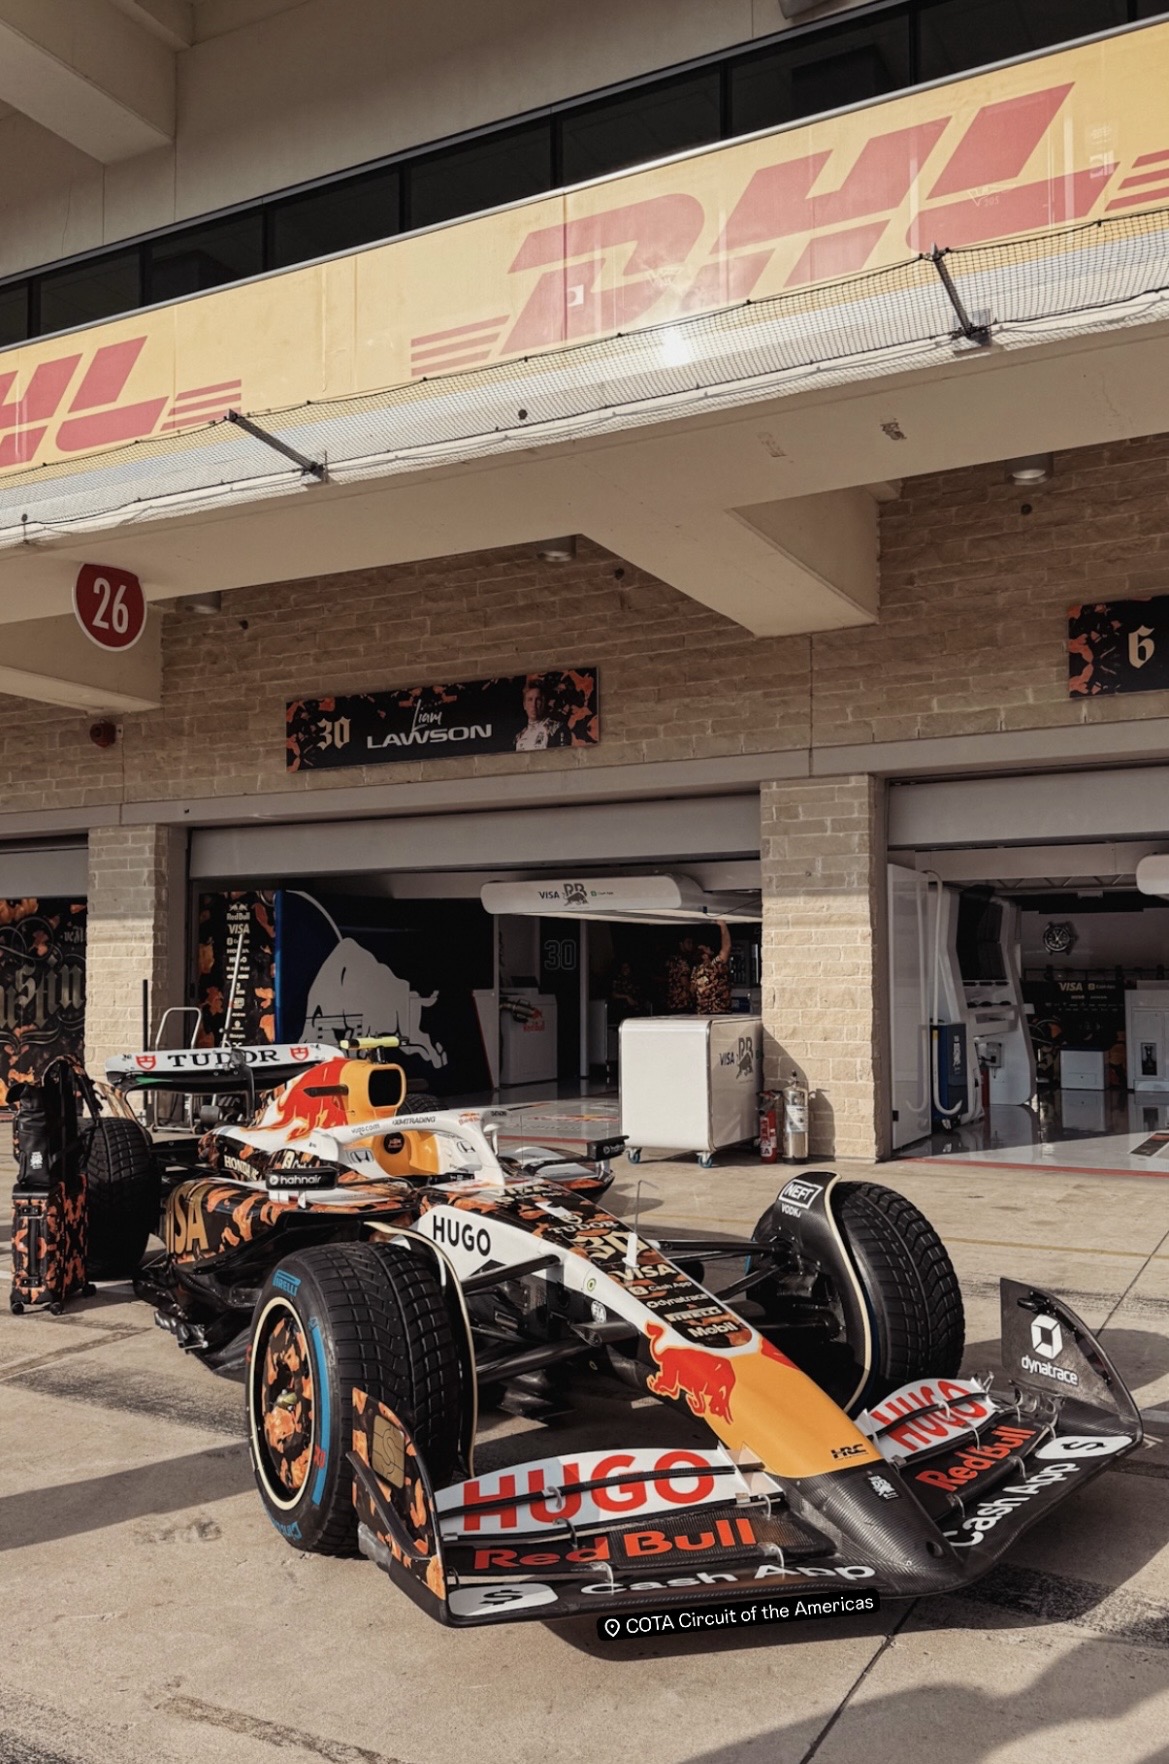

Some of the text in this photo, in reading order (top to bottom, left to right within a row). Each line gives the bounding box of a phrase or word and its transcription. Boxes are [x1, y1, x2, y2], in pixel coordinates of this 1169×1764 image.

[499, 82, 1120, 355] DHL
[0, 336, 169, 468] HL
[92, 577, 129, 634] 26
[1128, 625, 1155, 669] 6
[411, 699, 442, 732] Liam
[316, 717, 492, 750] 30 LAWSON
[538, 891, 560, 899] VISA
[228, 923, 250, 934] VISA
[544, 939, 576, 970] 30
[1059, 982, 1083, 991] VISA
[167, 1049, 280, 1068] TUDOR
[280, 1175, 322, 1185] hahnair
[784, 1183, 815, 1200] NEFT
[433, 1215, 491, 1257] HUGO
[548, 1220, 619, 1234] TUDOR
[607, 1264, 677, 1281] VISA
[687, 1321, 739, 1337] Mobil
[1021, 1355, 1078, 1386] dynatrace
[871, 1380, 988, 1452] HUGO
[463, 1450, 715, 1531] HUGO
[943, 1462, 1080, 1547] Cash App
[474, 1518, 757, 1570] Red Bull
[581, 1572, 738, 1595] Cash
